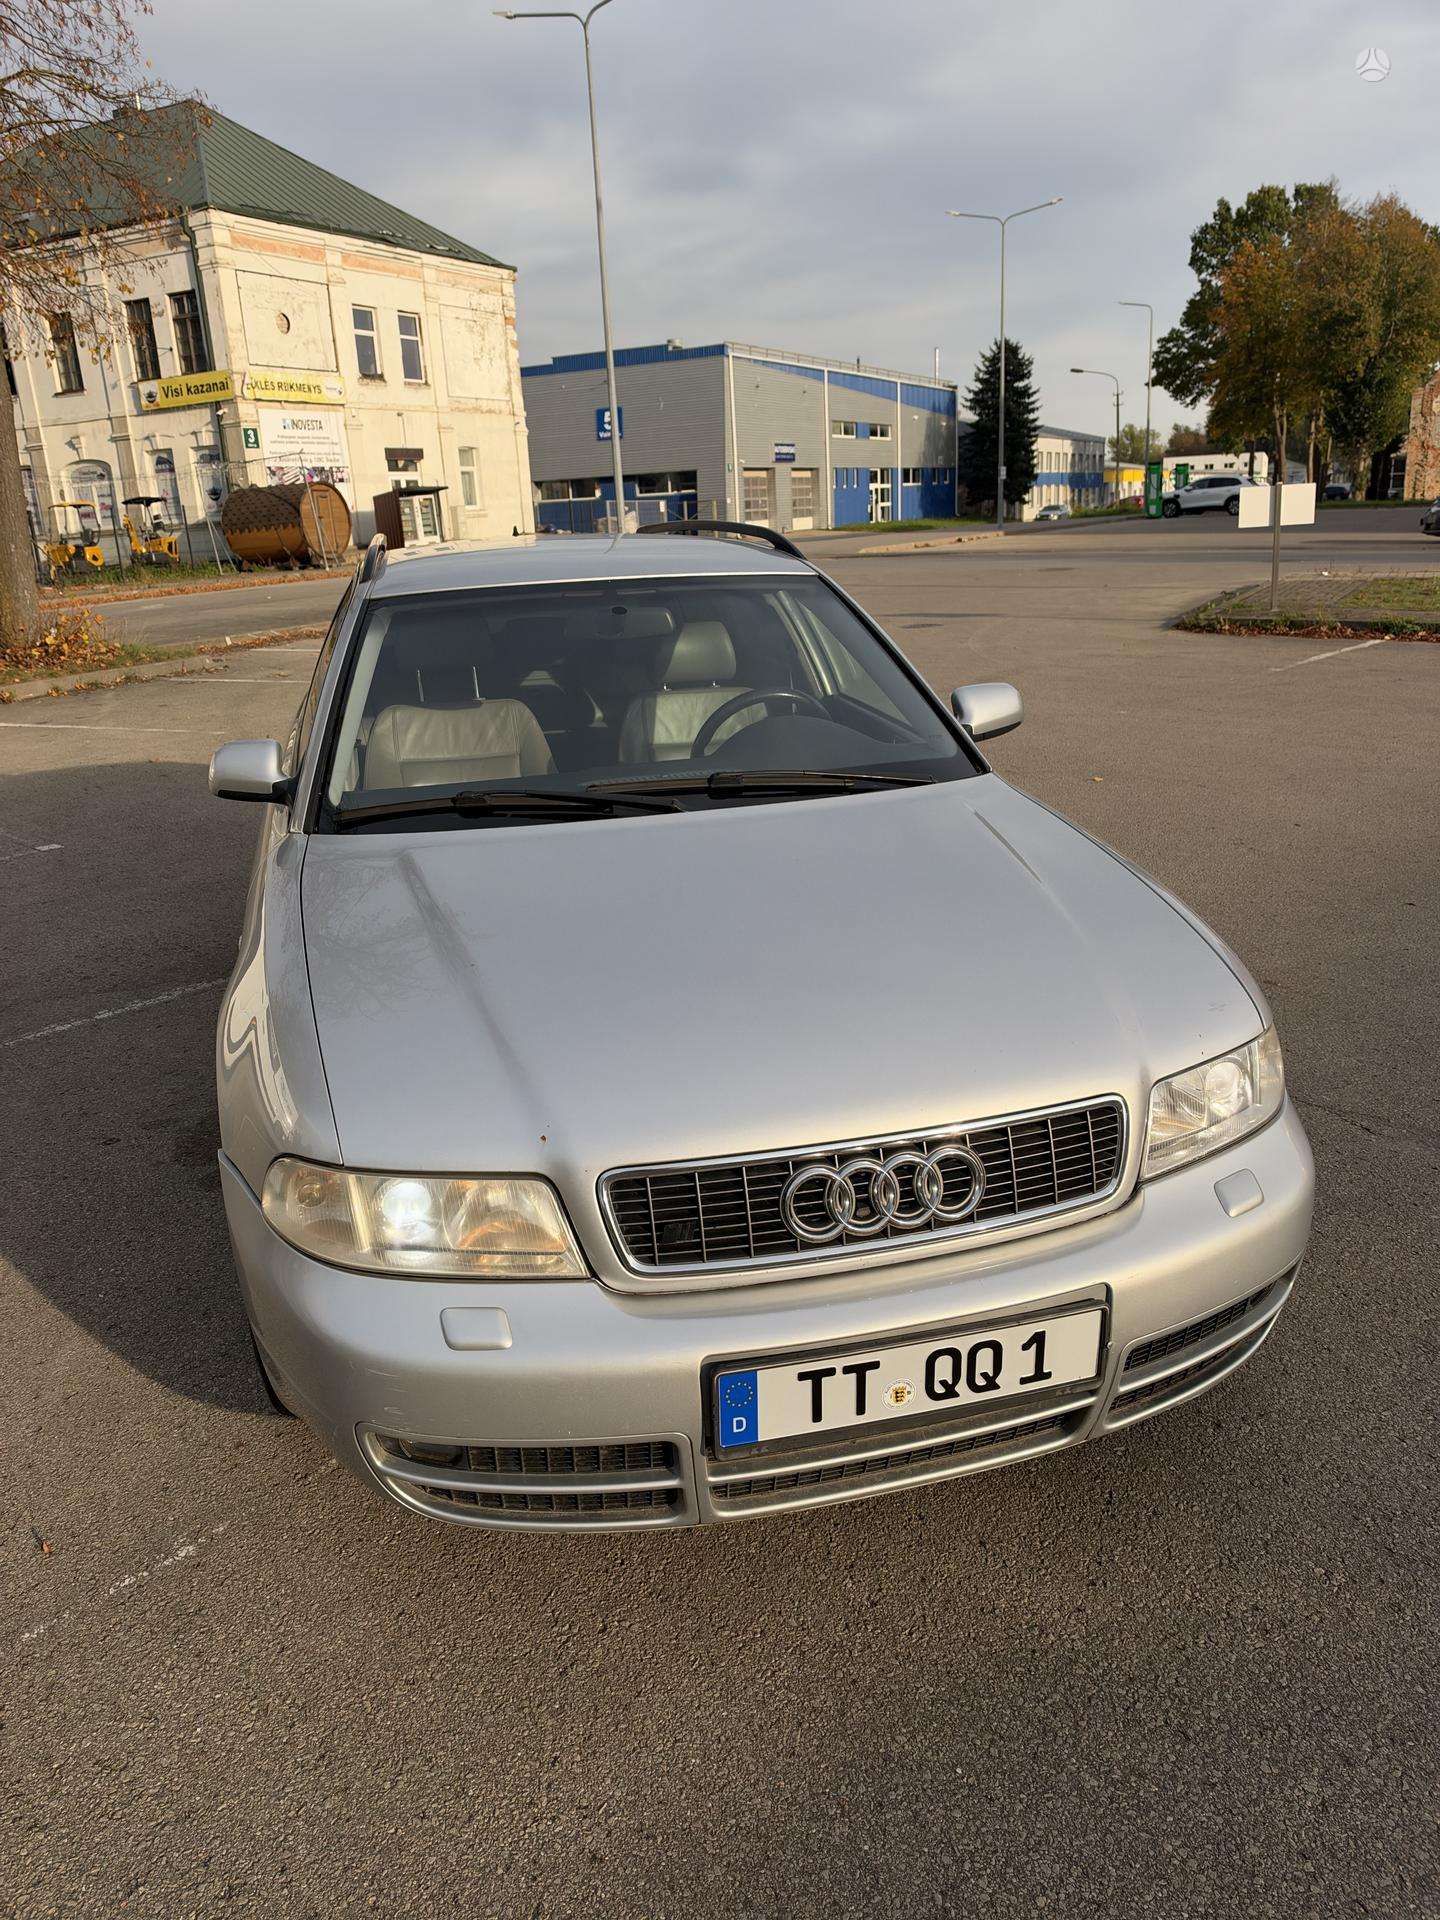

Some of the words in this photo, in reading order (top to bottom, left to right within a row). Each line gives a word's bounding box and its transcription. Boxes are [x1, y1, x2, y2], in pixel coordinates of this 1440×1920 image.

[162, 384, 183, 399] Visi
[186, 378, 229, 396] kazanai
[247, 429, 256, 443] 3
[797, 1360, 880, 1423] TT
[925, 1339, 1003, 1401] QQ
[1019, 1330, 1052, 1385] 1
[732, 1417, 747, 1433] D
